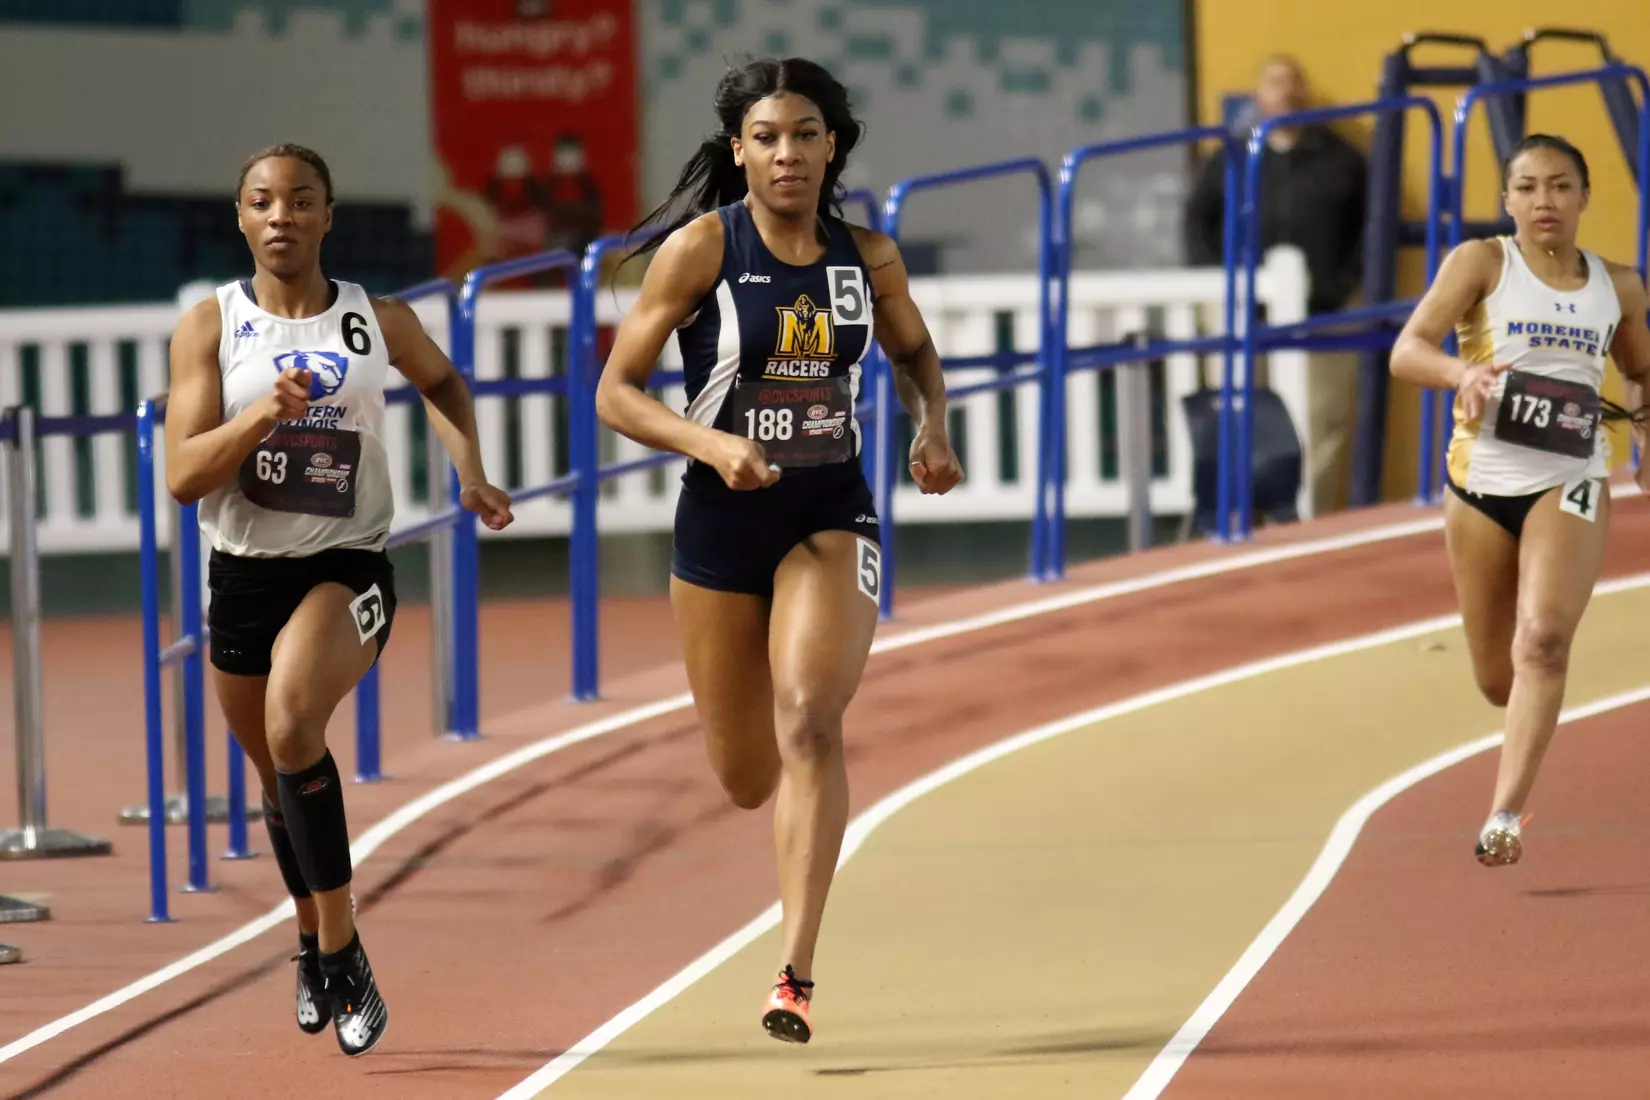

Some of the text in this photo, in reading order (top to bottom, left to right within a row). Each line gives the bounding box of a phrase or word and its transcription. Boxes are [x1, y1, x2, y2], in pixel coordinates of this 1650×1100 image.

[749, 275, 772, 284] asics
[834, 269, 863, 321] 5
[341, 311, 372, 356] 6
[1507, 322, 1600, 341] MOREHE
[1529, 336, 1597, 357] STATE
[764, 360, 831, 377] RACERS
[304, 406, 347, 418] TERN
[744, 408, 793, 441] 188
[1510, 393, 1552, 428] 173
[256, 450, 288, 485] 63
[1566, 480, 1592, 515] 4
[860, 544, 879, 597] 5
[357, 594, 382, 635] 6
